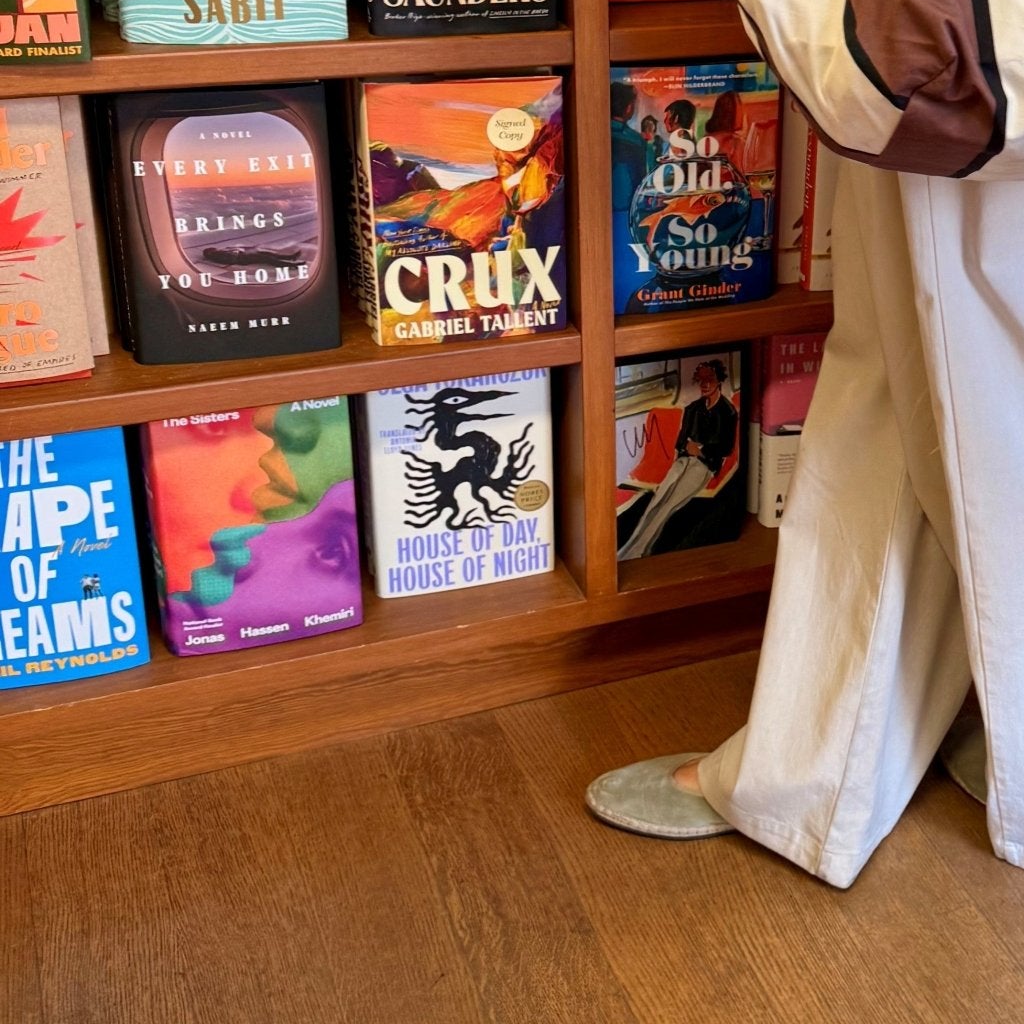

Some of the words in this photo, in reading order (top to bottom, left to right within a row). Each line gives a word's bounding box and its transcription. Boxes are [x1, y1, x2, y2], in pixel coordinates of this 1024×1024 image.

[27, 45, 82, 56] FINALIST
[212, 131, 252, 139] NOVEL
[495, 118, 527, 129] Signed
[498, 129, 524, 141] Copy
[669, 128, 720, 158] So
[133, 159, 227, 177] EVERY
[249, 153, 313, 172] EXIT
[652, 161, 733, 194] Old.
[175, 212, 286, 234] BRINGS
[668, 216, 718, 247] So
[628, 236, 754, 273] Young
[158, 272, 213, 290] YOU
[233, 264, 310, 286] HOME
[384, 245, 562, 316] CRUX
[637, 285, 684, 302] Grant
[688, 282, 742, 297] Ginder
[188, 321, 240, 333] NAEEM
[249, 316, 290, 328] MURR
[395, 317, 475, 340] GABRIEL
[479, 308, 559, 331] TALLENT
[290, 401, 301, 412] A
[303, 396, 340, 409] Novel
[190, 411, 240, 425] Sisters
[70, 537, 114, 558] Novel
[397, 527, 463, 564] HOUSE
[471, 524, 497, 553] OF
[502, 517, 541, 548] DAY,
[10, 551, 58, 603] OF
[388, 559, 455, 593] HOUSE
[461, 552, 487, 583] OF
[493, 543, 551, 579] NIGHT
[185, 632, 225, 646] Jonas
[240, 621, 289, 638] Hassen
[304, 606, 355, 628] Khemiri
[26, 644, 140, 675] REYNOLDS
